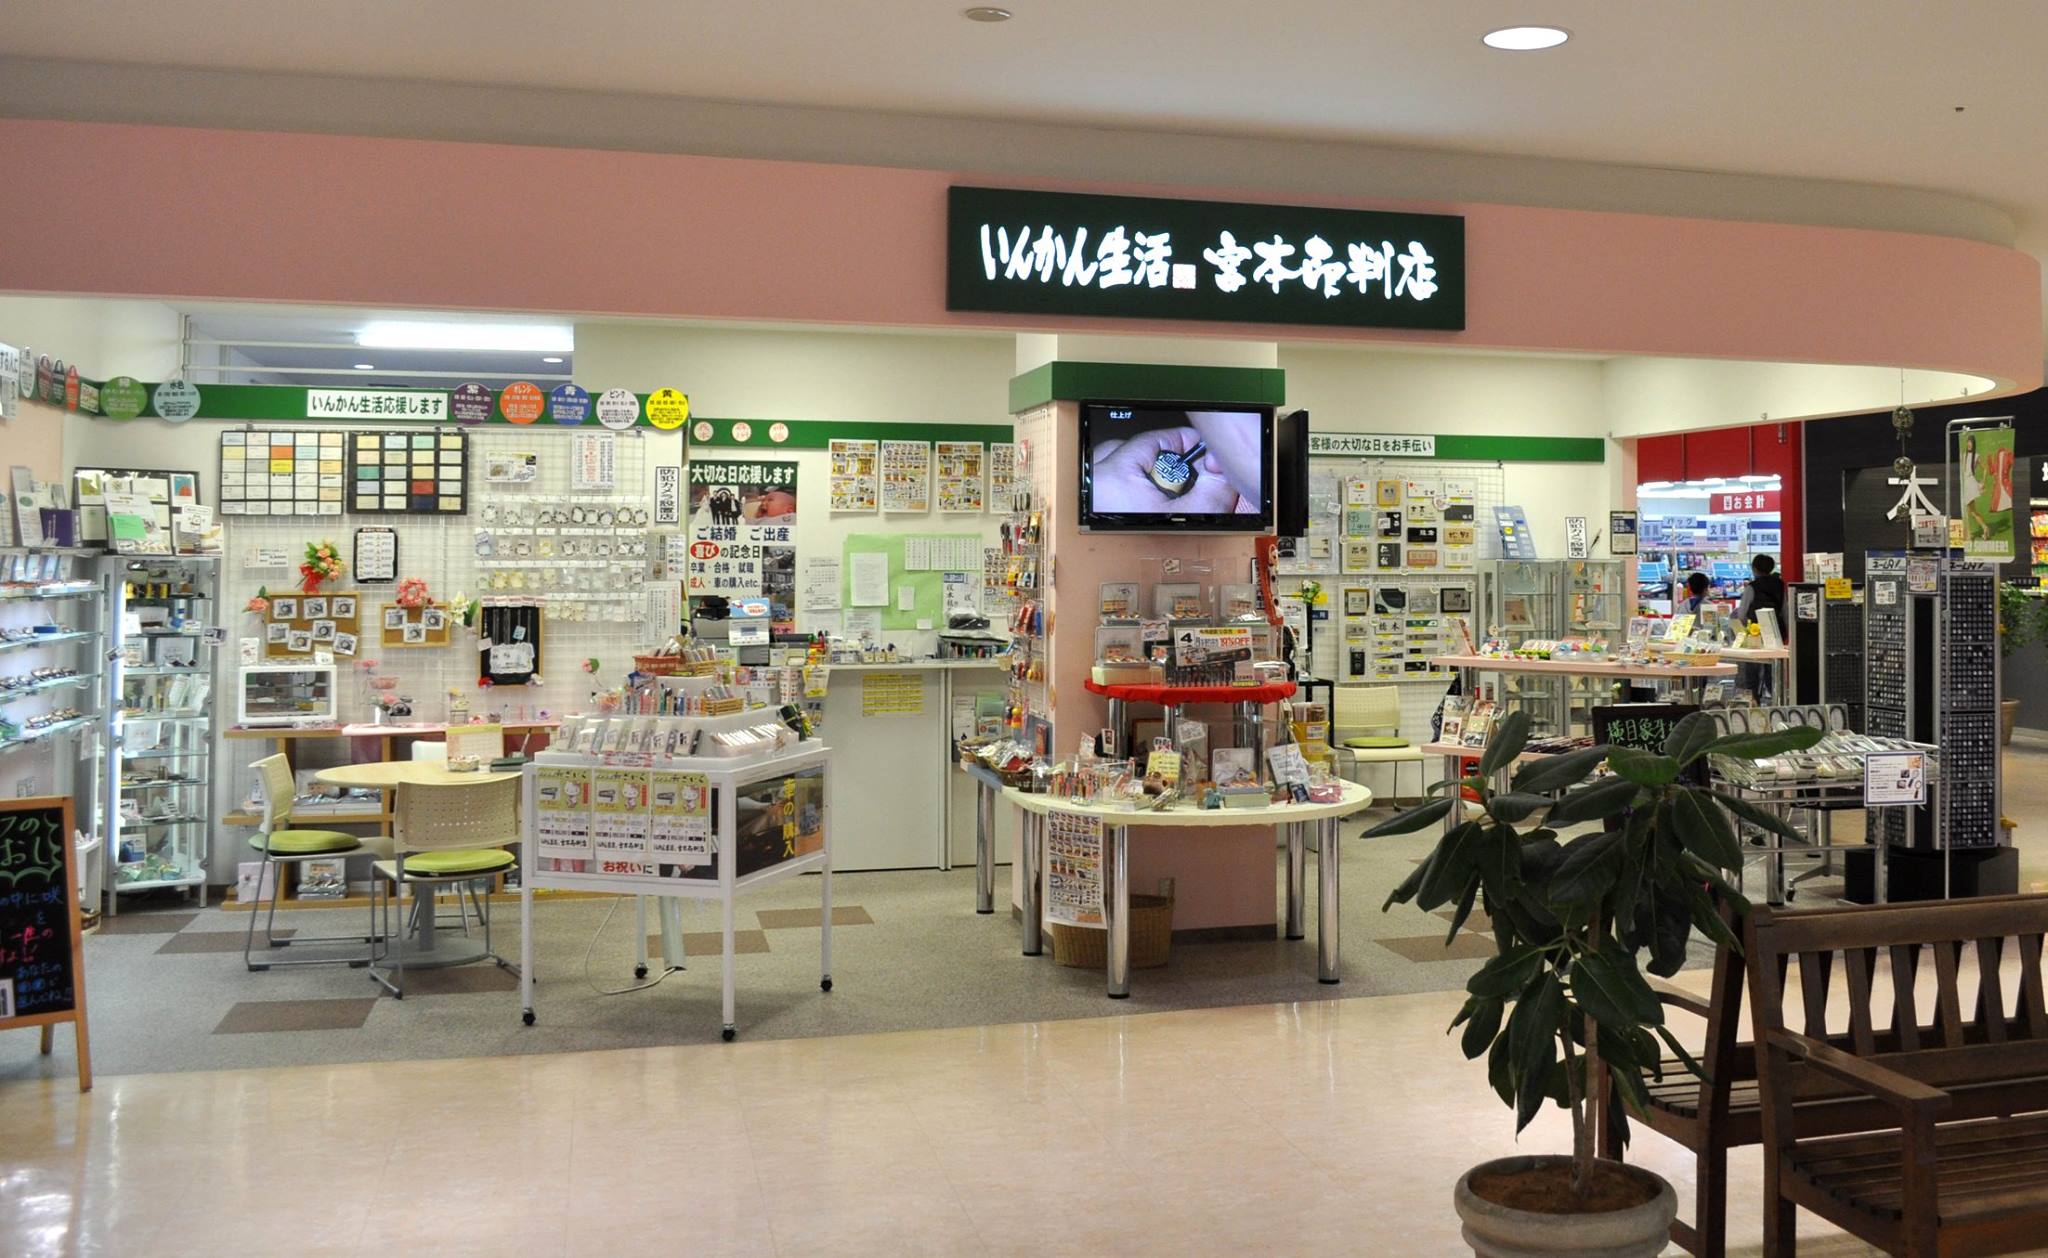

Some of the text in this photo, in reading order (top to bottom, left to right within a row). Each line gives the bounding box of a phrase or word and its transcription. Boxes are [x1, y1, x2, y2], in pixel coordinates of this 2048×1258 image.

[979, 224, 1439, 301] いんかん生活 宮本印判店
[311, 394, 443, 416] いんかん生活応援します
[1110, 410, 1133, 419] 仕上げ
[691, 464, 795, 484] 大切な日応援します
[1733, 494, 1765, 509] お会計
[696, 526, 790, 542] ご結婚 ご出産
[694, 542, 761, 559] 喜びの記念日
[1606, 717, 1674, 745] 横目象牙
[783, 777, 796, 858] 車の購入
[602, 859, 653, 875] お祝いに
